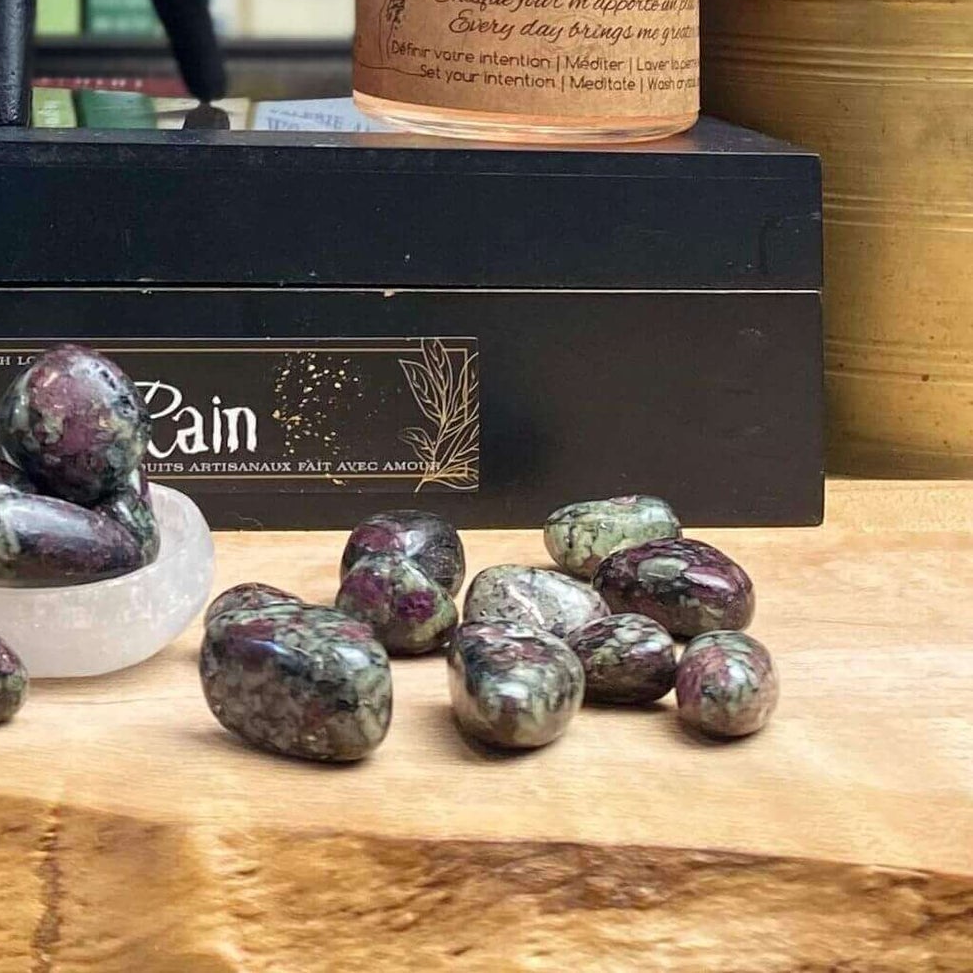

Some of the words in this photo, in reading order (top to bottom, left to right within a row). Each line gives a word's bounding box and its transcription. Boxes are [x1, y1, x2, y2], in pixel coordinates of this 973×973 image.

[449, 8, 516, 41] Every
[519, 18, 564, 44] day
[568, 18, 633, 46] brings
[636, 26, 660, 41] me
[390, 39, 431, 58] Définir
[435, 46, 476, 63] votre
[479, 50, 552, 70] intention
[565, 54, 625, 72] Méditer
[419, 64, 441, 80] Set
[445, 71, 480, 85] your
[484, 69, 556, 88] intention
[570, 74, 636, 91] Meditate
[140, 461, 184, 473] UITS
[188, 461, 292, 473] ARTISANAUX
[297, 459, 333, 473] FAIT
[336, 460, 380, 473] AVEC
